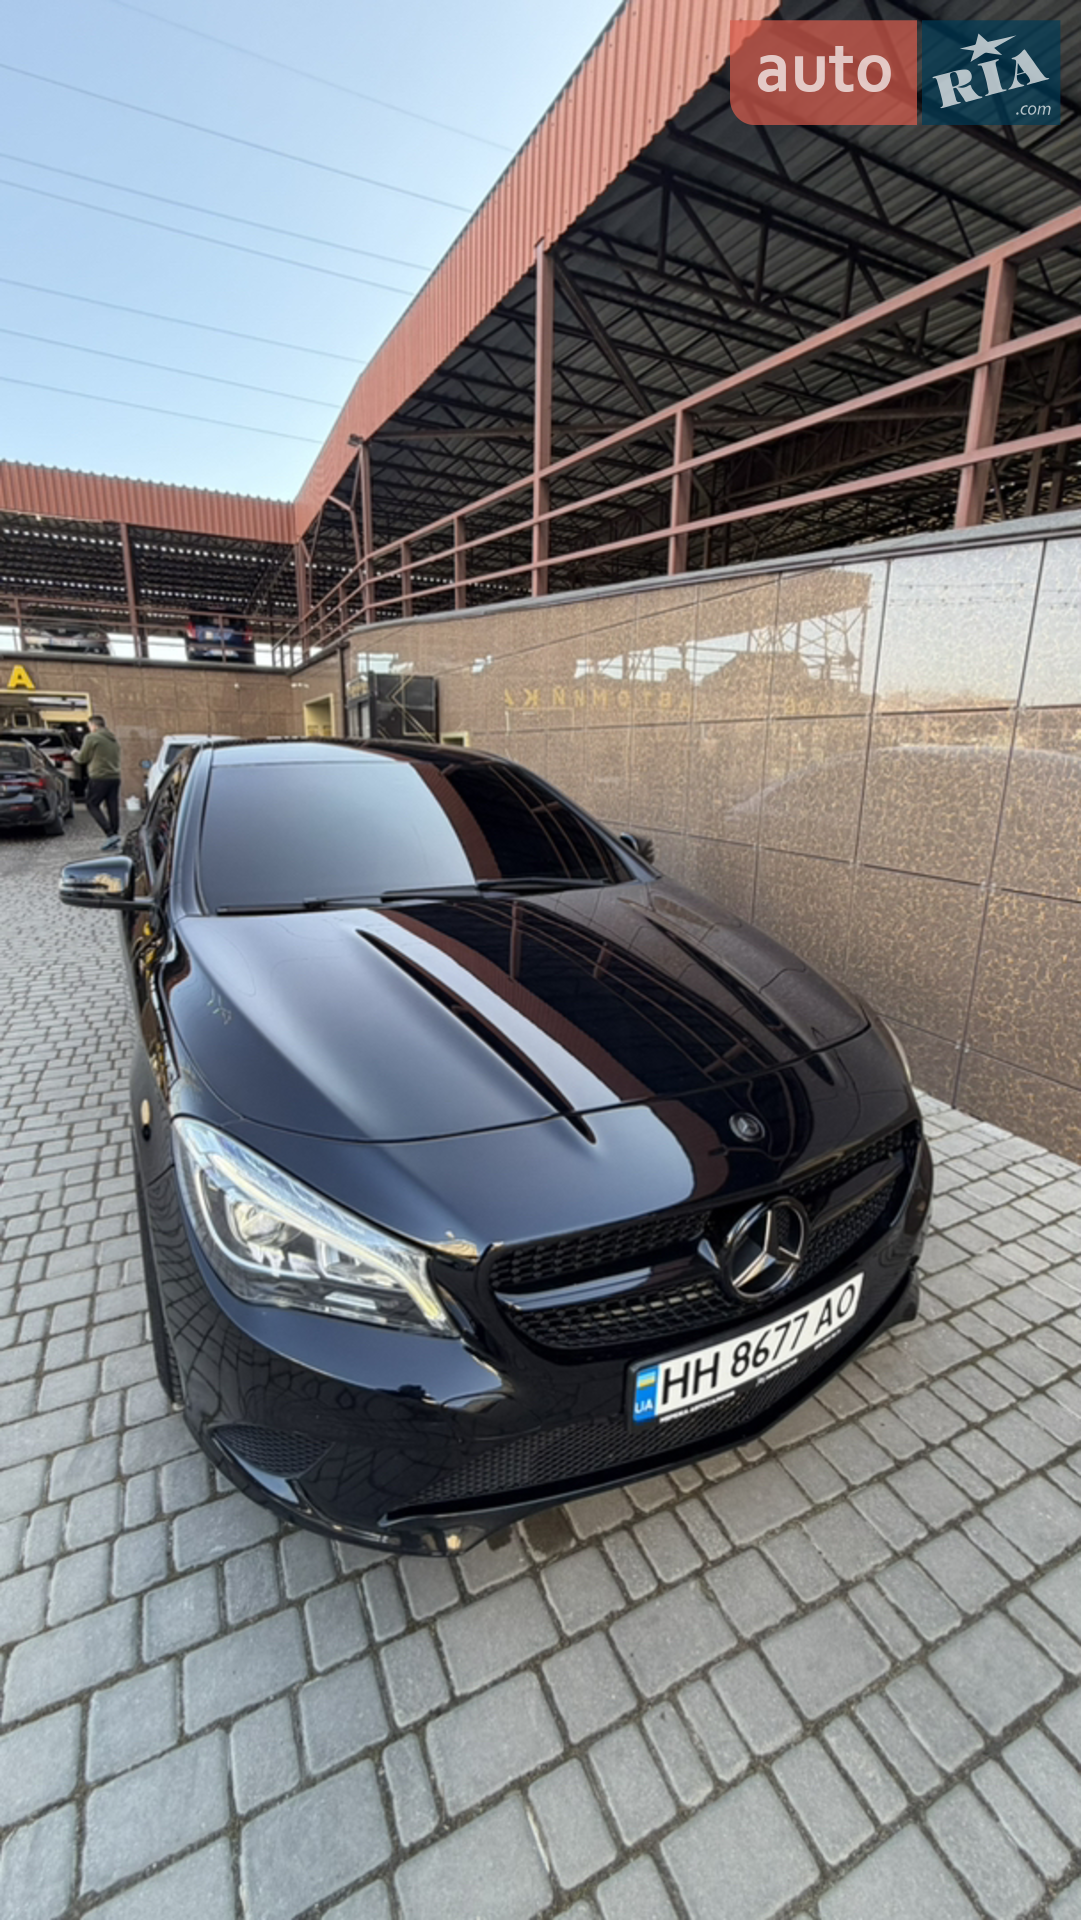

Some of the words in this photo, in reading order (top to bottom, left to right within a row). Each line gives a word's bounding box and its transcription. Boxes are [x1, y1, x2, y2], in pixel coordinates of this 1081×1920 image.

[661, 1351, 720, 1405] HH
[731, 1311, 809, 1378] 8677
[814, 1283, 856, 1336] AO
[634, 1399, 653, 1414] UA
